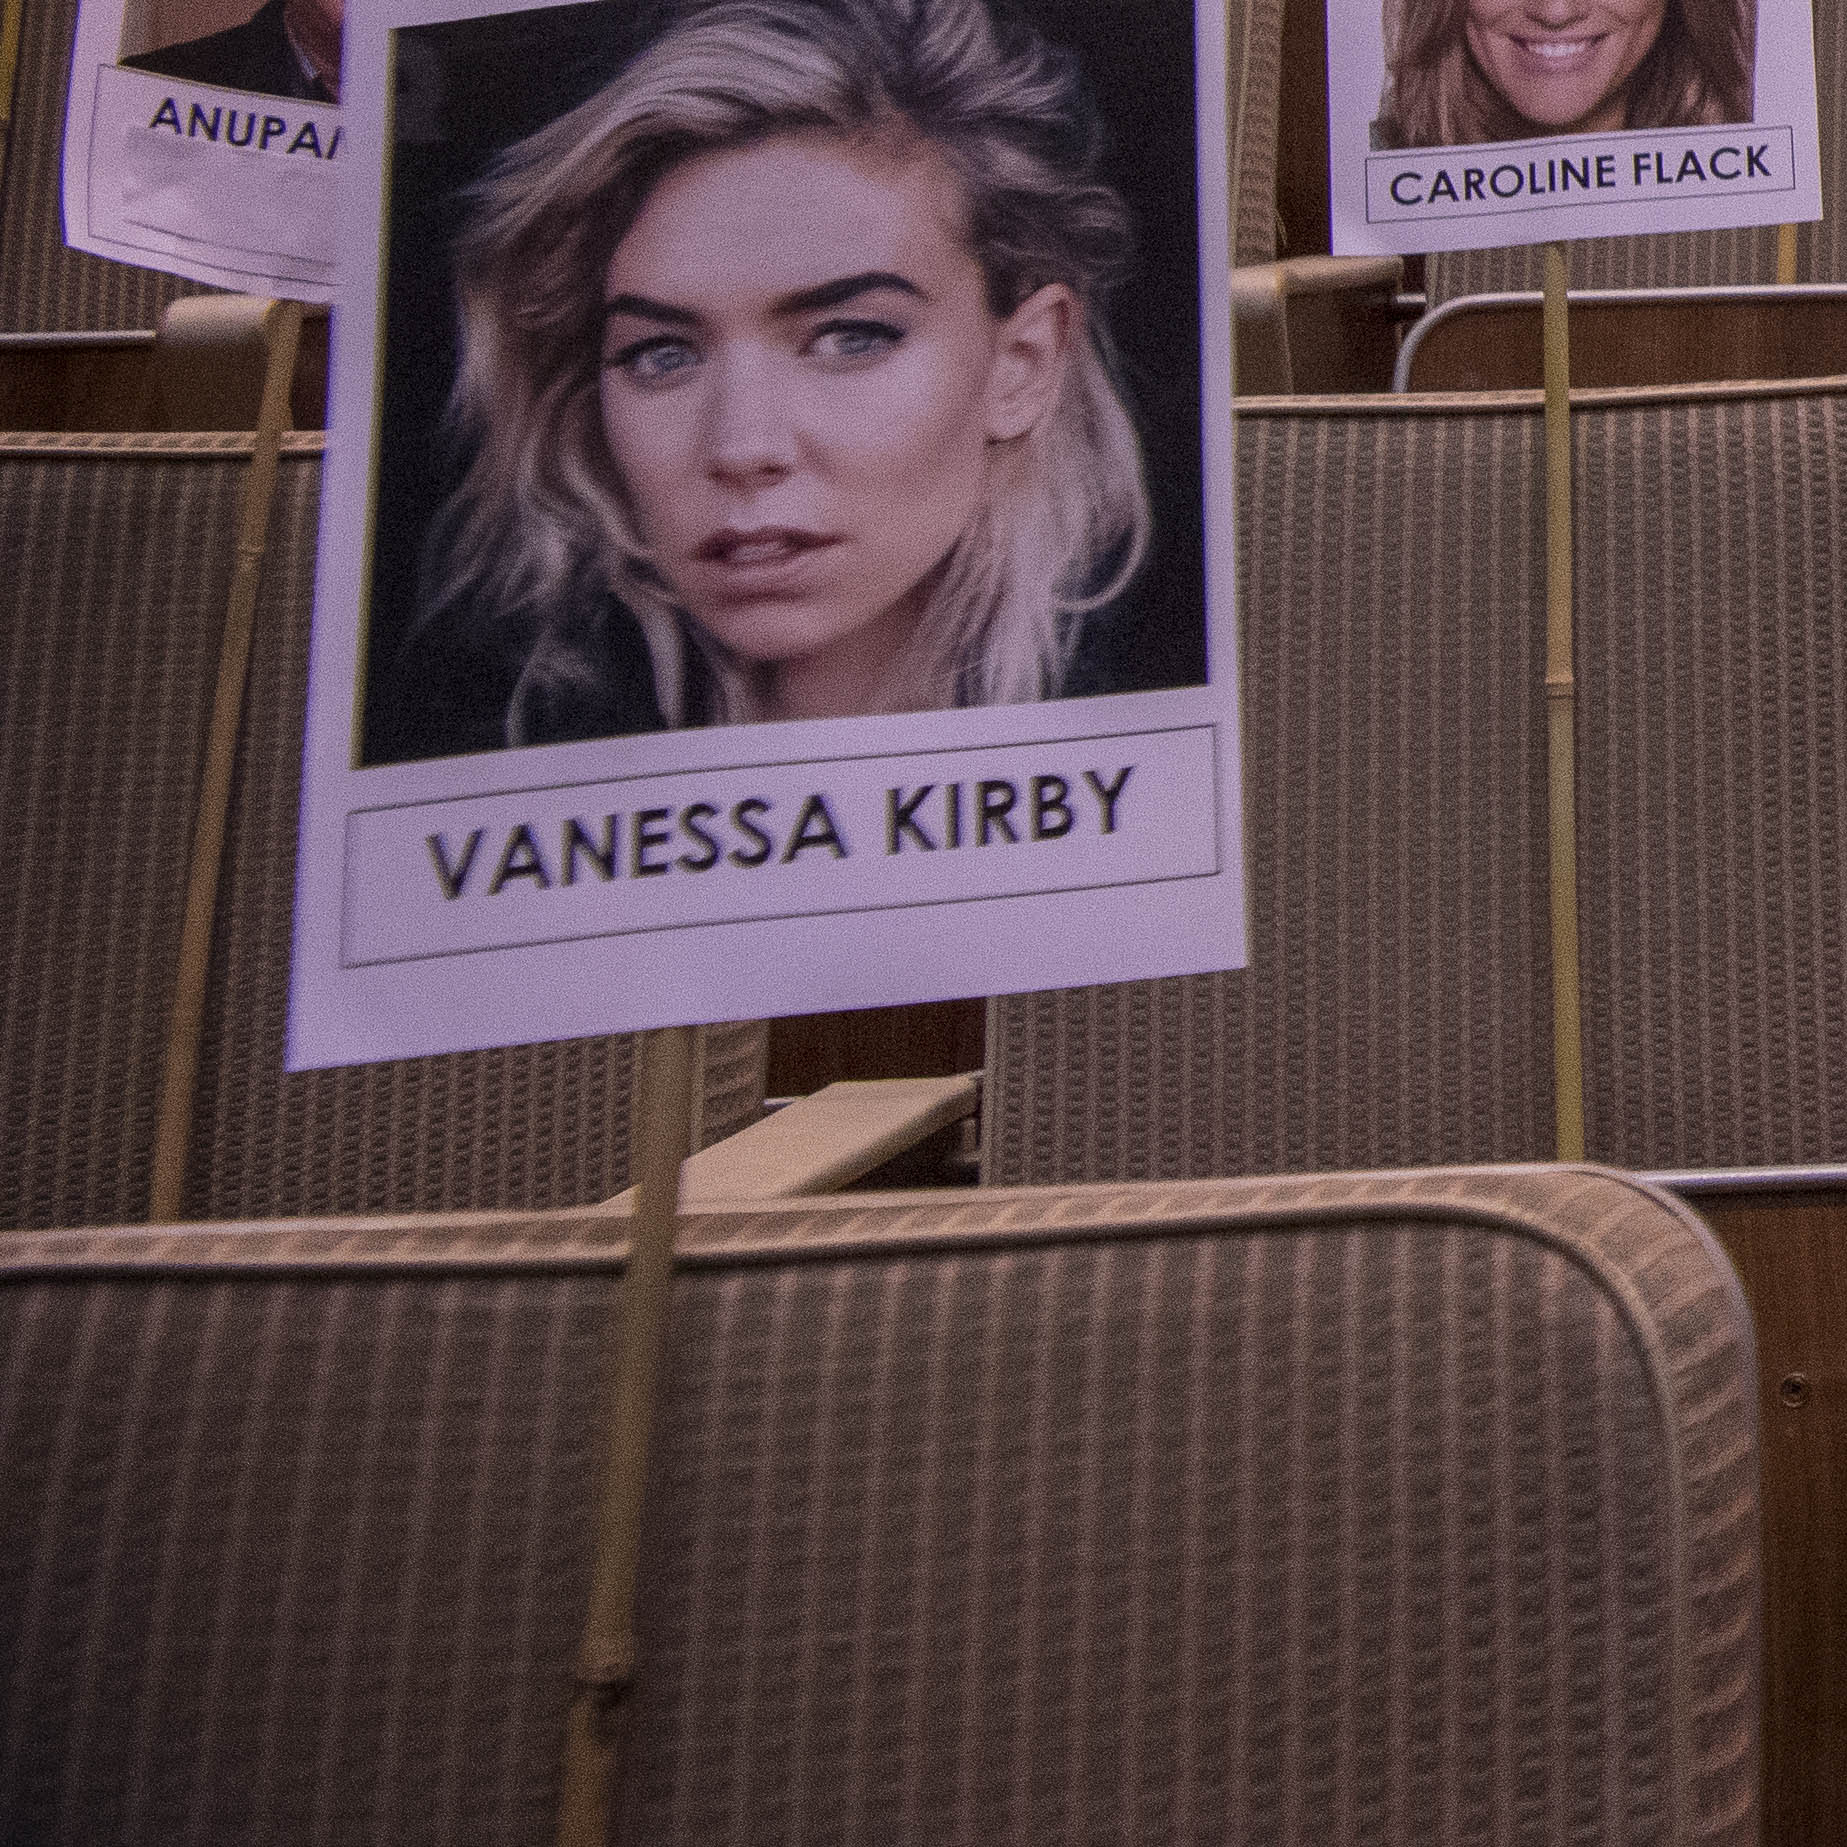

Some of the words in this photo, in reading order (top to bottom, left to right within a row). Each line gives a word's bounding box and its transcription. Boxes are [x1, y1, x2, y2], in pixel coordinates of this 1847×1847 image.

[1390, 154, 1616, 206] CAROLINE
[1632, 144, 1772, 187] FLACK
[424, 794, 850, 902] VANESSA
[884, 764, 1138, 857] KIRBY
